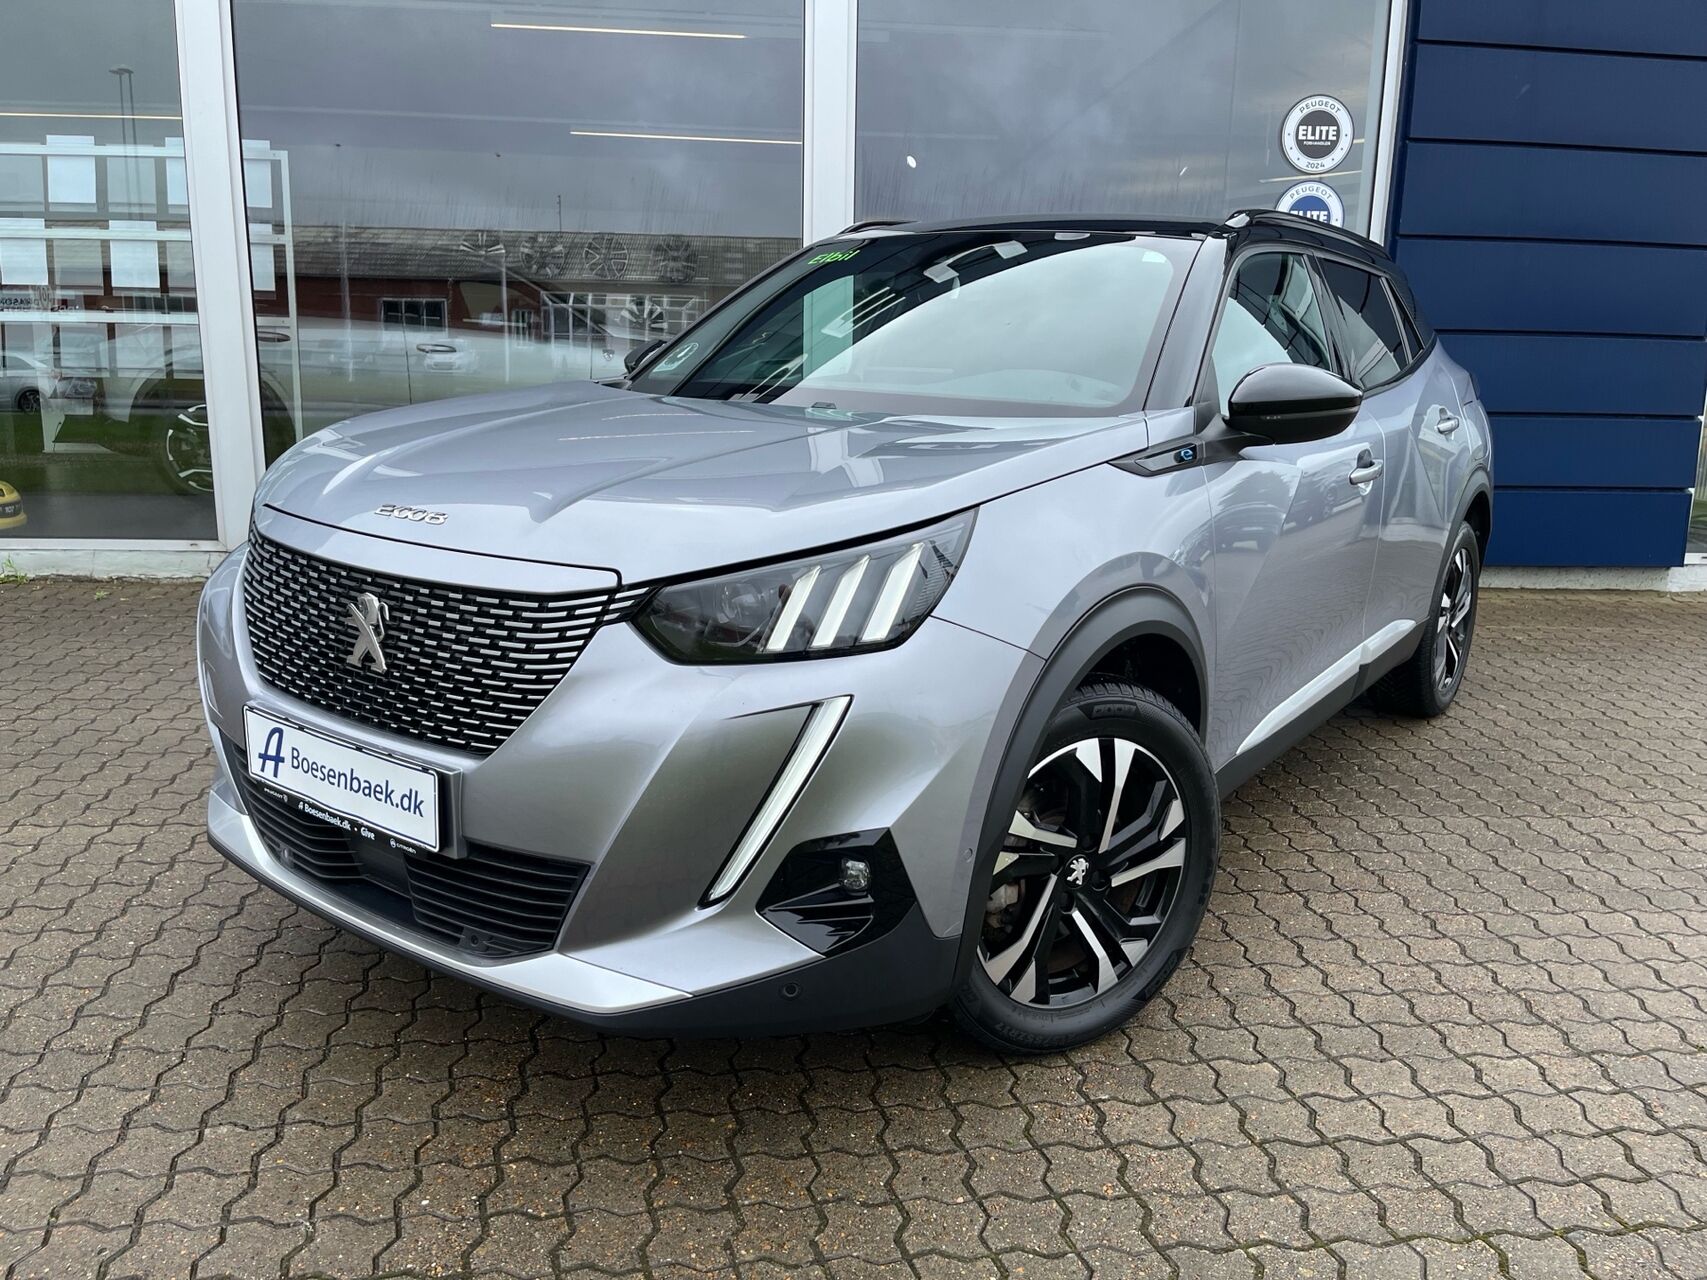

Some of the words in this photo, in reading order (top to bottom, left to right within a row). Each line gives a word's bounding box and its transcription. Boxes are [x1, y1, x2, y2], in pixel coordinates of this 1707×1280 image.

[1299, 100, 1341, 114] PEUGEOT
[1298, 125, 1338, 141] ELITE
[1305, 161, 1326, 169] 2024
[1289, 185, 1333, 200] PEUGEOT
[808, 249, 860, 265] Elbil
[374, 503, 449, 525] 2008
[291, 746, 424, 818] Boesenbaek.dk
[360, 826, 375, 840] Give
